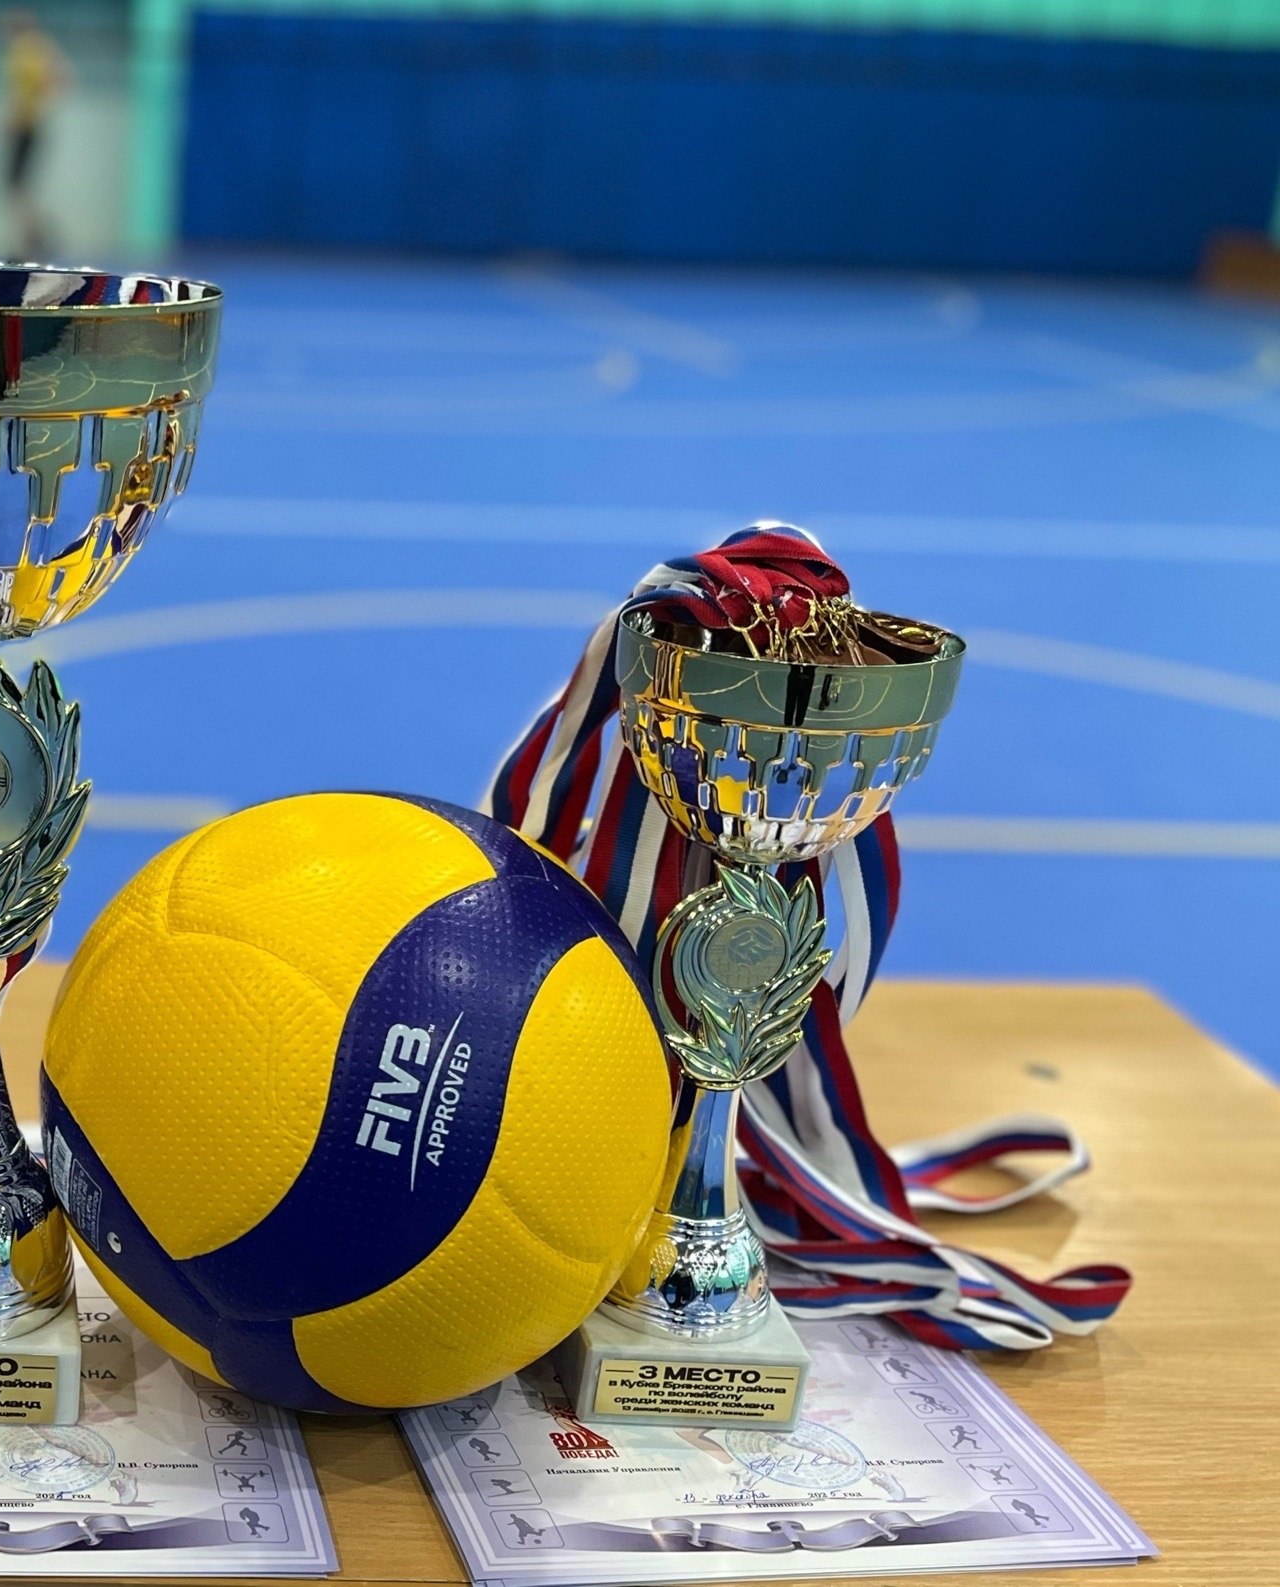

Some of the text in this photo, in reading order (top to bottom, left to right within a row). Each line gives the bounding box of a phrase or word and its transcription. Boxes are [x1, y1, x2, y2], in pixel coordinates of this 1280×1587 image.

[355, 1023, 431, 1156] FIVB
[425, 1042, 472, 1167] APPROVED
[638, 1365, 761, 1384] 3 МЕСТО
[620, 1379, 660, 1390] Кубке
[662, 1381, 734, 1393] Брянского
[736, 1383, 786, 1395] района
[613, 1397, 775, 1411] среди женских команд
[667, 1390, 743, 1402] волейболу
[549, 1432, 585, 1449] 80
[559, 1449, 620, 1460] ПОБЕДА!
[545, 1467, 609, 1475] Начальник
